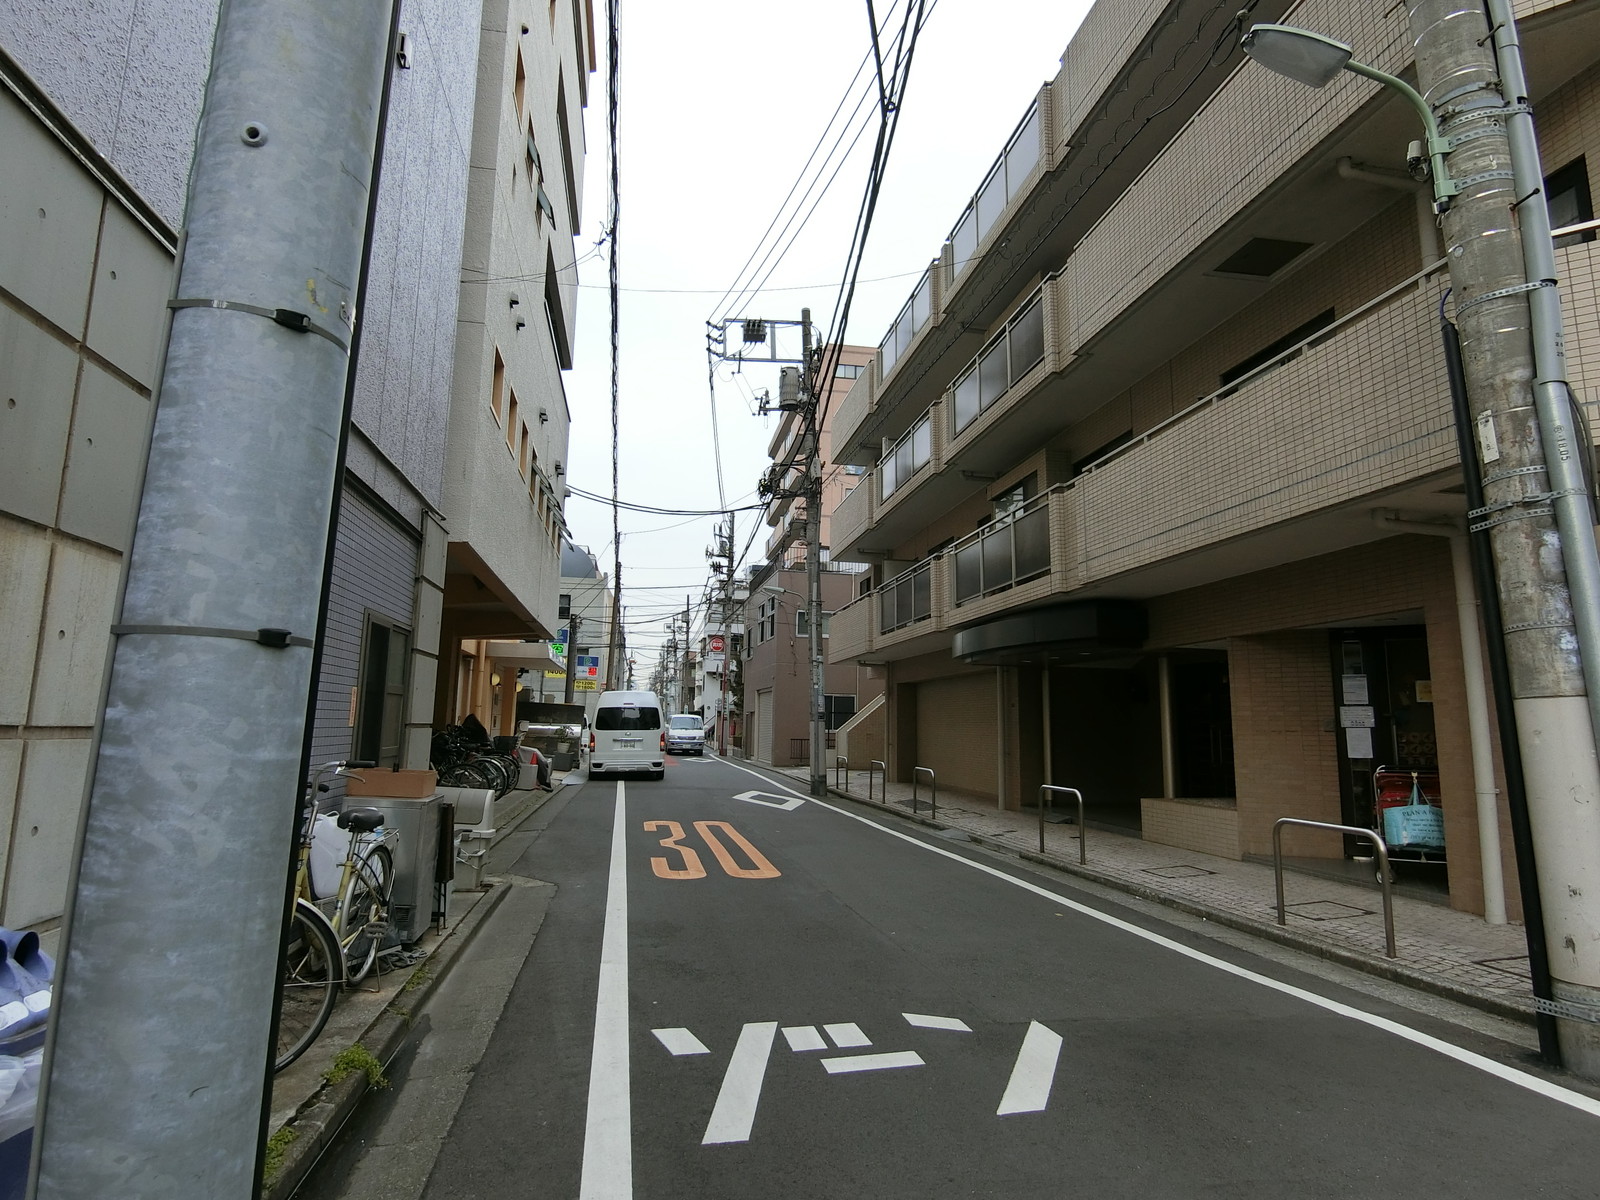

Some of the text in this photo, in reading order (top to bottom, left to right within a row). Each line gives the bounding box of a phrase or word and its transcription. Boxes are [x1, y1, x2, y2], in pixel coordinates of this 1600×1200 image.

[643, 820, 782, 880] 30
[650, 1012, 1064, 1145] ゾーン
